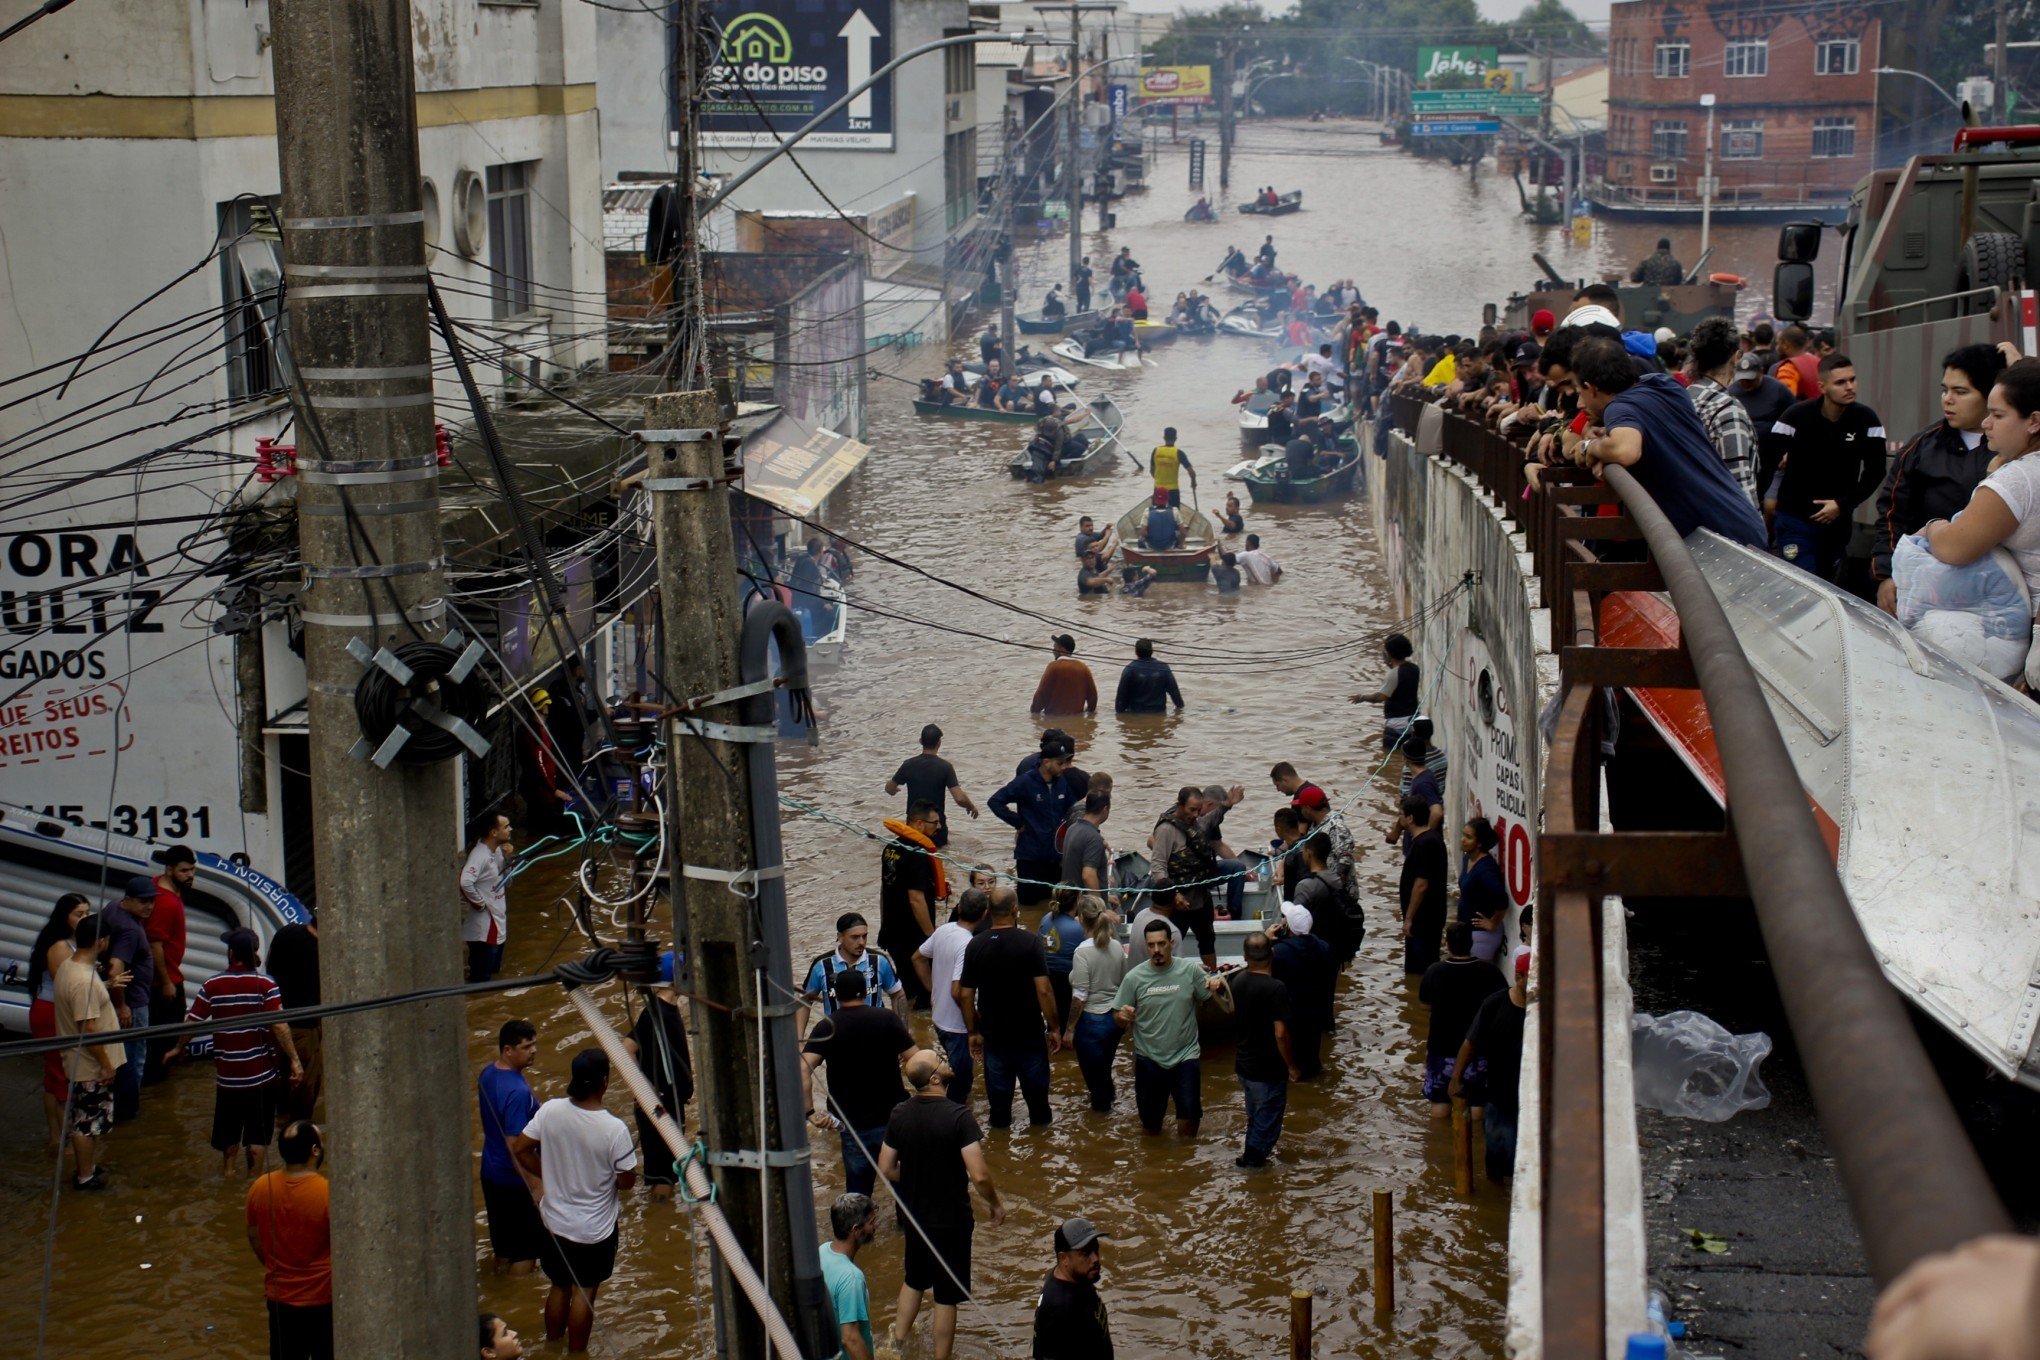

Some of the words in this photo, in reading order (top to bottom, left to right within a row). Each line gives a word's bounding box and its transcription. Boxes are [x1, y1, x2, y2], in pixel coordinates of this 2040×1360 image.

[743, 63, 775, 82] do
[778, 65, 828, 84] piso
[0, 533, 150, 578] ORA
[1, 589, 164, 635] ULTZ
[0, 649, 106, 680] GADOS
[1496, 763, 1520, 792] CAPAS
